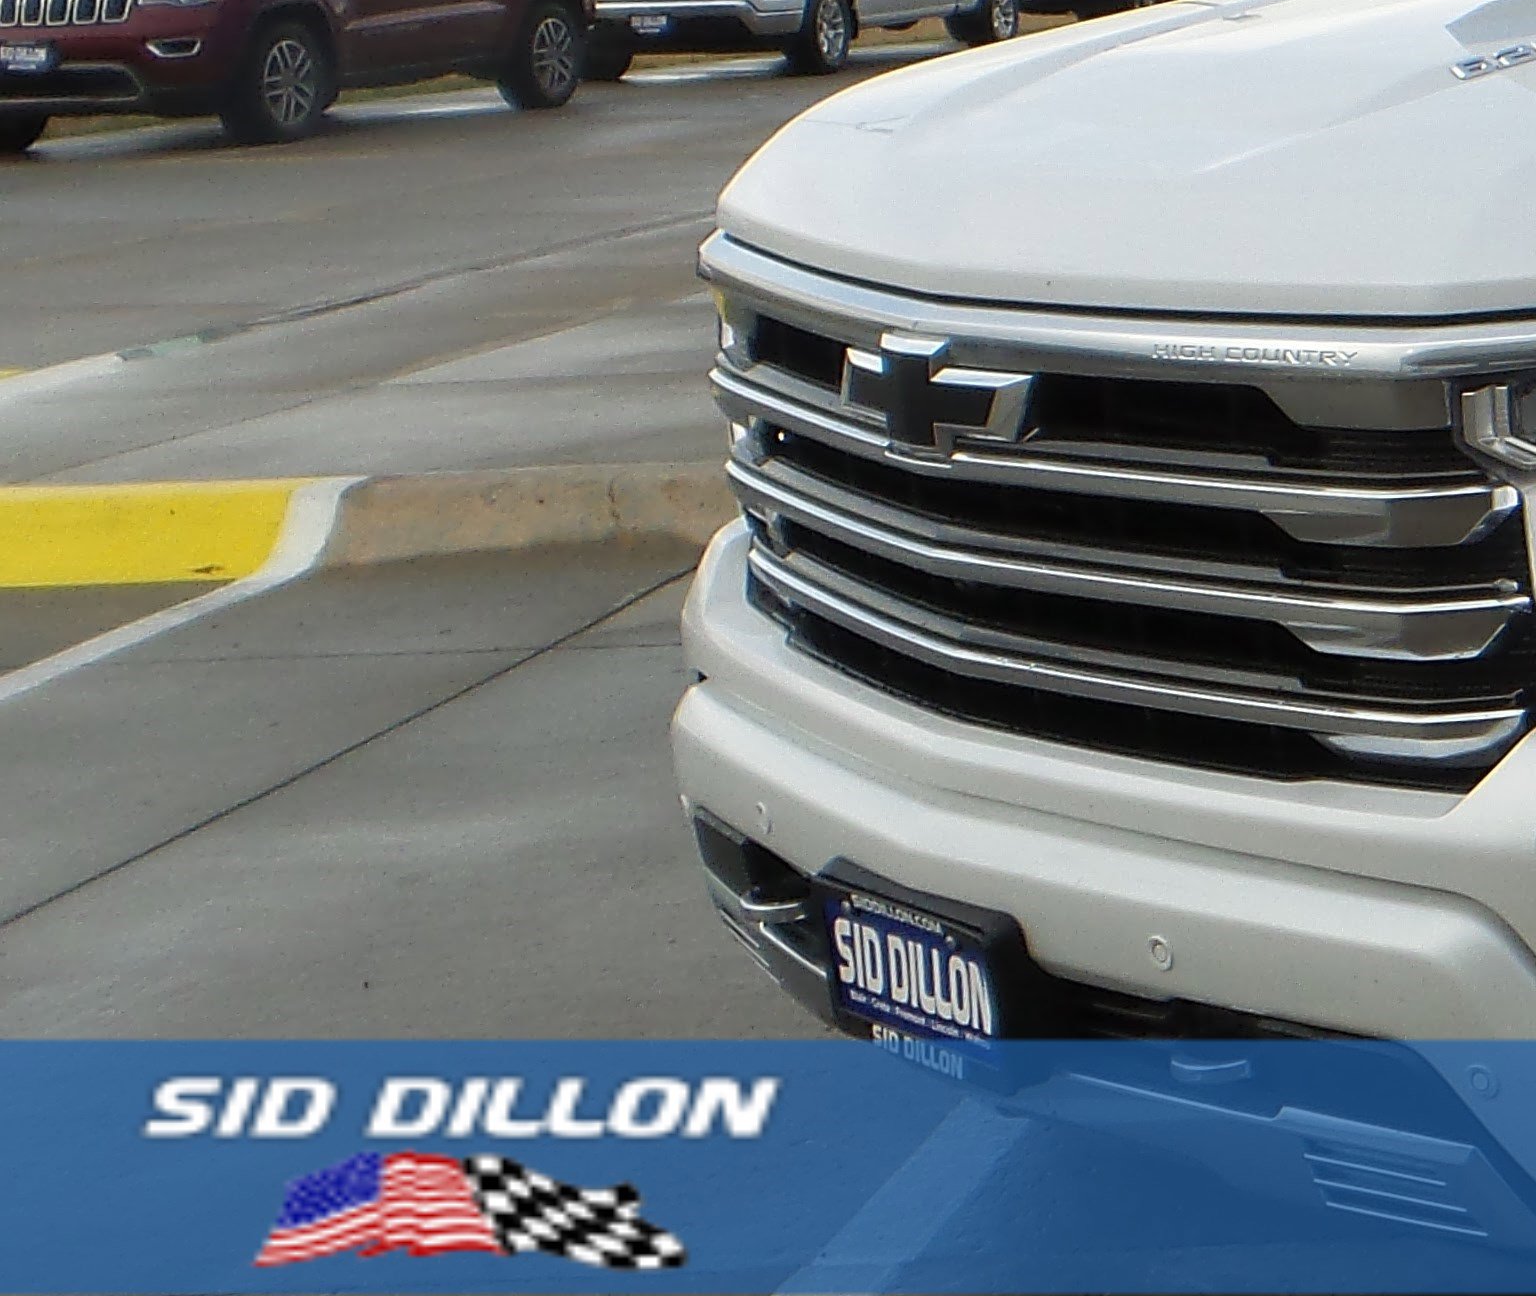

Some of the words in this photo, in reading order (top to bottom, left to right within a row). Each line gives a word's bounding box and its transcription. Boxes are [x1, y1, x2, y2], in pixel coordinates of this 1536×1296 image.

[1153, 343, 1215, 361] HIGH
[1224, 347, 1358, 366] COUNTRY
[834, 917, 883, 995] SID
[887, 933, 992, 1035] DILLON
[872, 1024, 899, 1053] SID
[903, 1037, 963, 1080] DILLON
